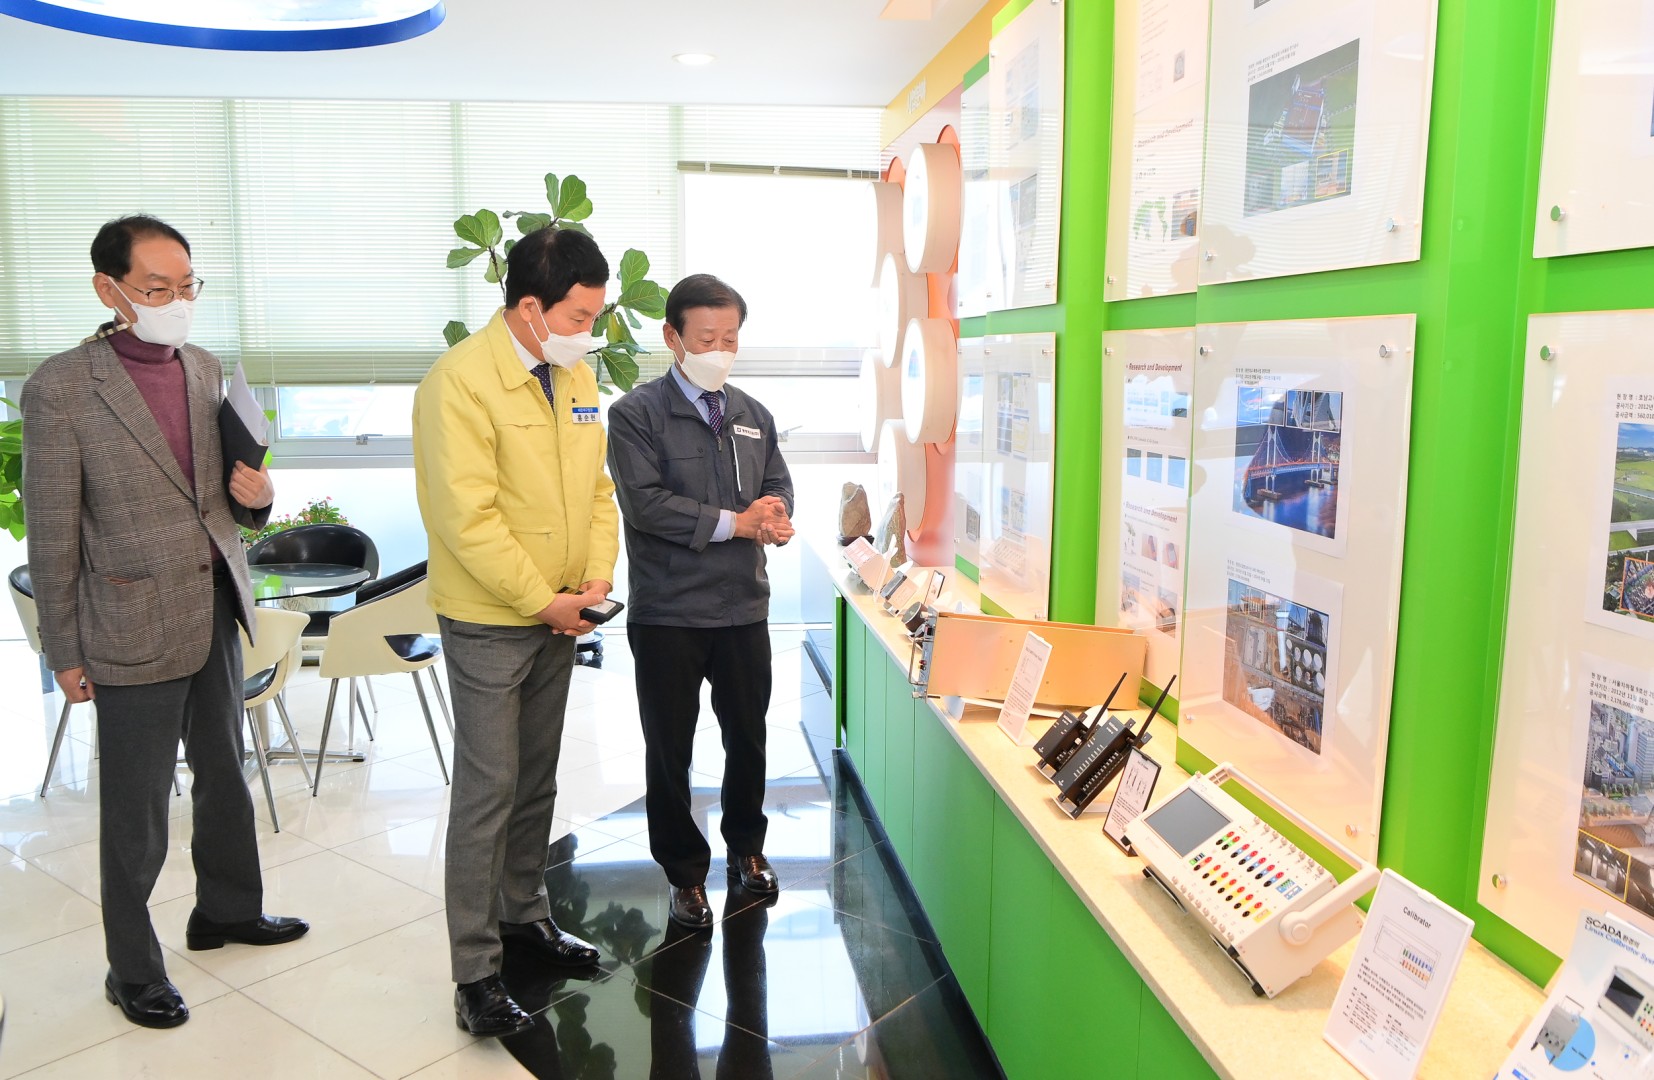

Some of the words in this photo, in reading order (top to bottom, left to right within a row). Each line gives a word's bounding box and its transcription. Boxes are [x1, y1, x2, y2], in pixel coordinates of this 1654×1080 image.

[1129, 363, 1146, 371] Research
[1155, 363, 1182, 372] Development
[1126, 501, 1143, 512] Research
[1151, 510, 1178, 524] Development
[1403, 906, 1432, 930] Calibrator
[1584, 923, 1604, 938] Linux
[1605, 934, 1640, 957] Calibrator
